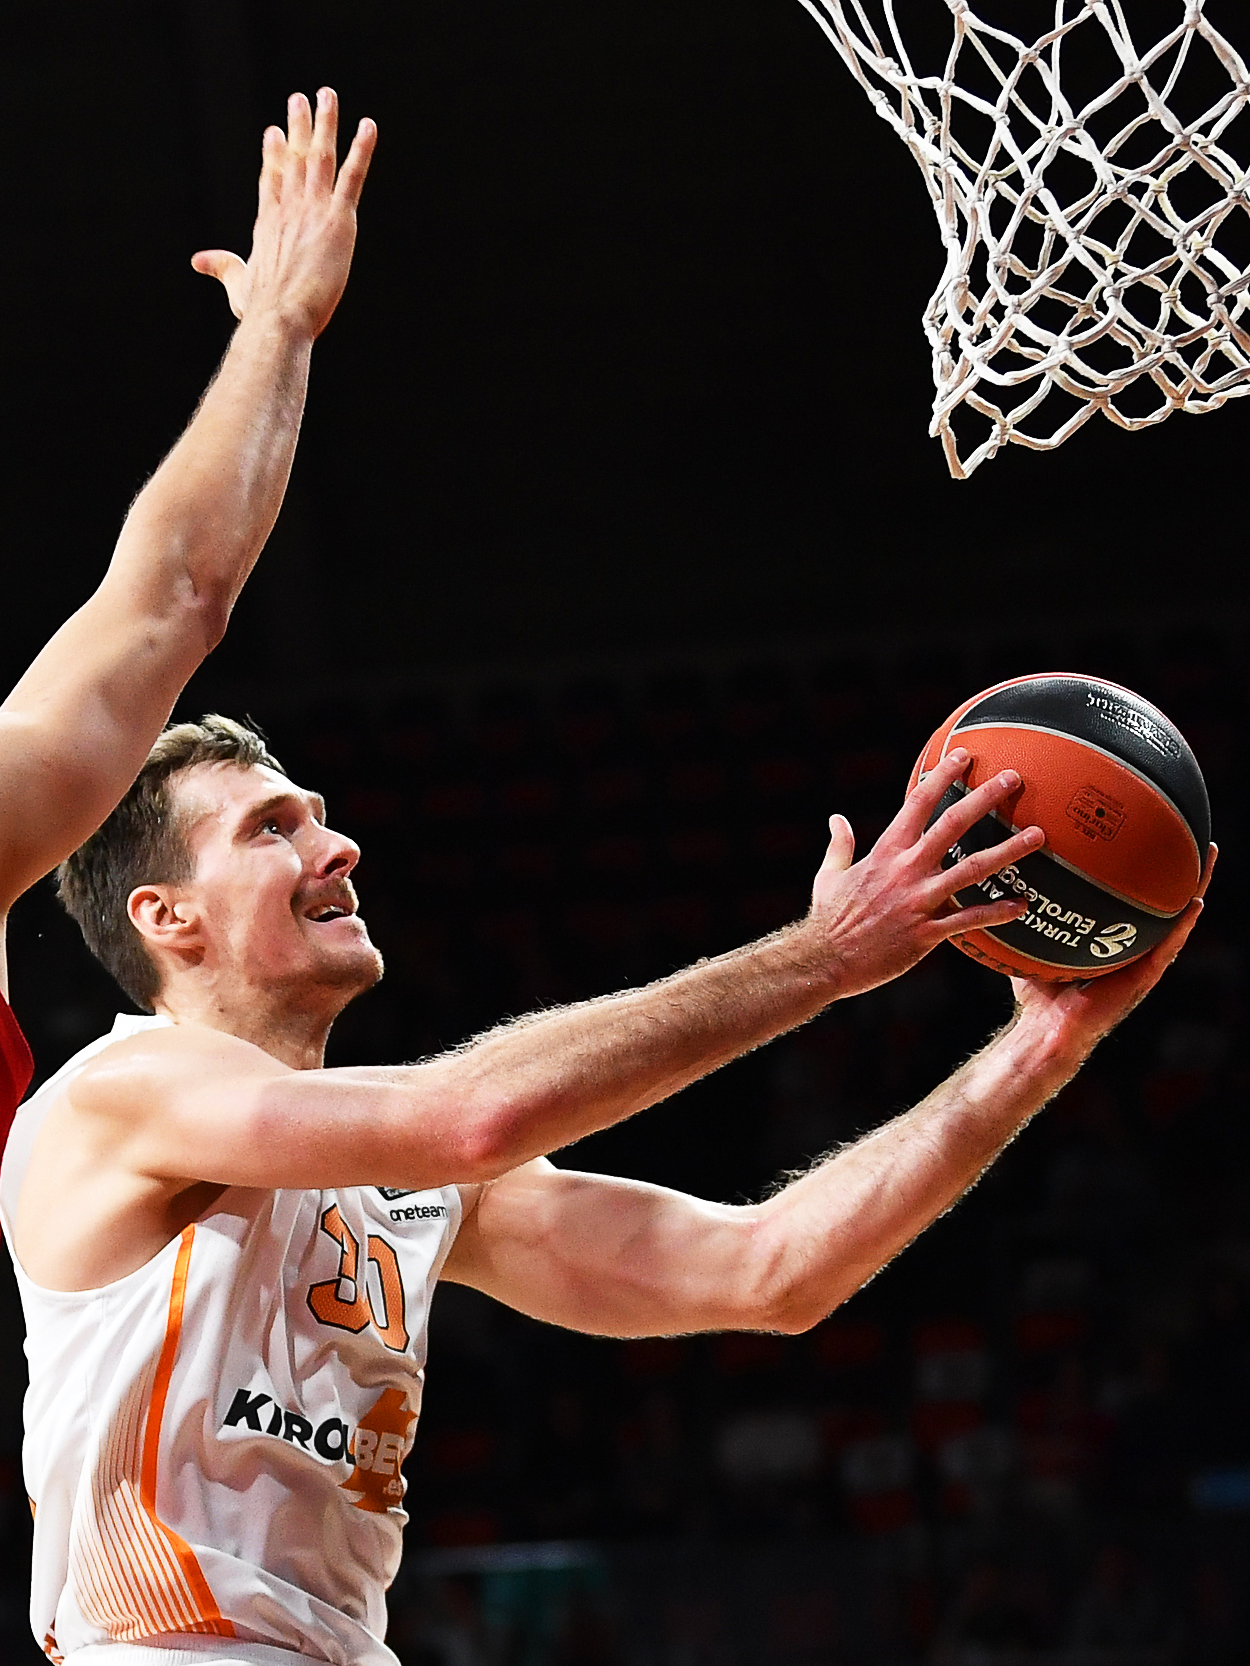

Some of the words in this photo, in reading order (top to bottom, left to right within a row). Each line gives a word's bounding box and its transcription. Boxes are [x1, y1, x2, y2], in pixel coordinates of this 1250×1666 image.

[995, 865, 1097, 935] EuroLeag
[1016, 911, 1081, 948] TURKIS
[390, 1204, 448, 1223] oneteam
[307, 1204, 410, 1353] 30
[224, 1388, 403, 1474] KIROLBE
